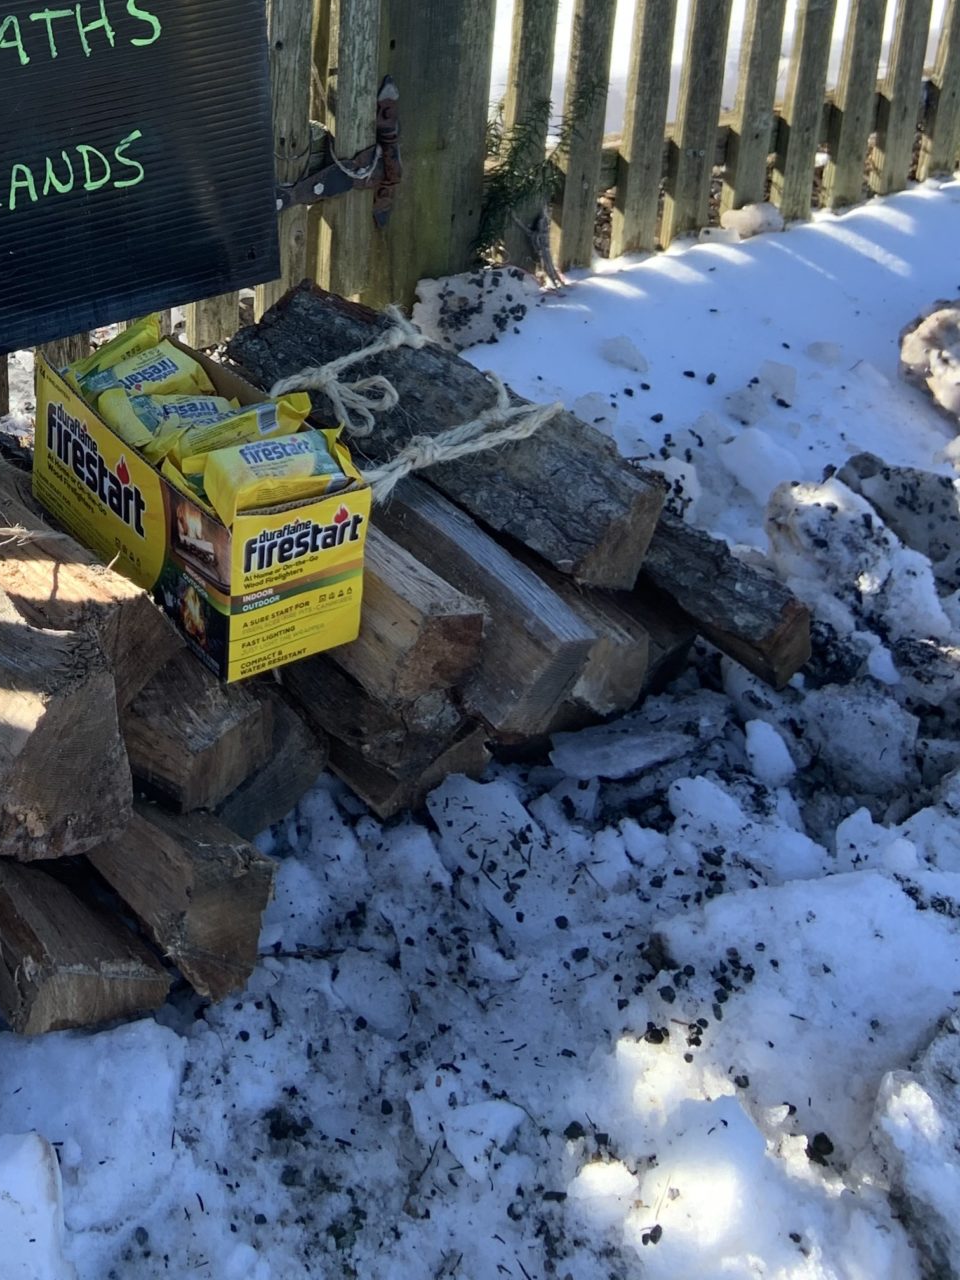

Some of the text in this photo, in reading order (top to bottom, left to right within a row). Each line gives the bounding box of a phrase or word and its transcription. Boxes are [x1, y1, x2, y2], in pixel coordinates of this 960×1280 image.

[118, 358, 179, 390] firestart
[57, 403, 97, 455] duraflame
[239, 440, 313, 464] firestart
[48, 403, 145, 538] firestart
[259, 520, 311, 542] duraflame
[244, 514, 363, 573] firestart
[243, 588, 273, 602] INDOOR
[244, 580, 264, 589] Wood
[243, 595, 280, 612] OUTDOOR
[250, 614, 269, 626] SURE
[271, 606, 293, 619] START
[294, 600, 310, 610] FOR
[241, 625, 295, 649] FAST LIGHTING
[240, 652, 275, 669] COMPACT
[240, 648, 307, 675] WATER RESISTANT
